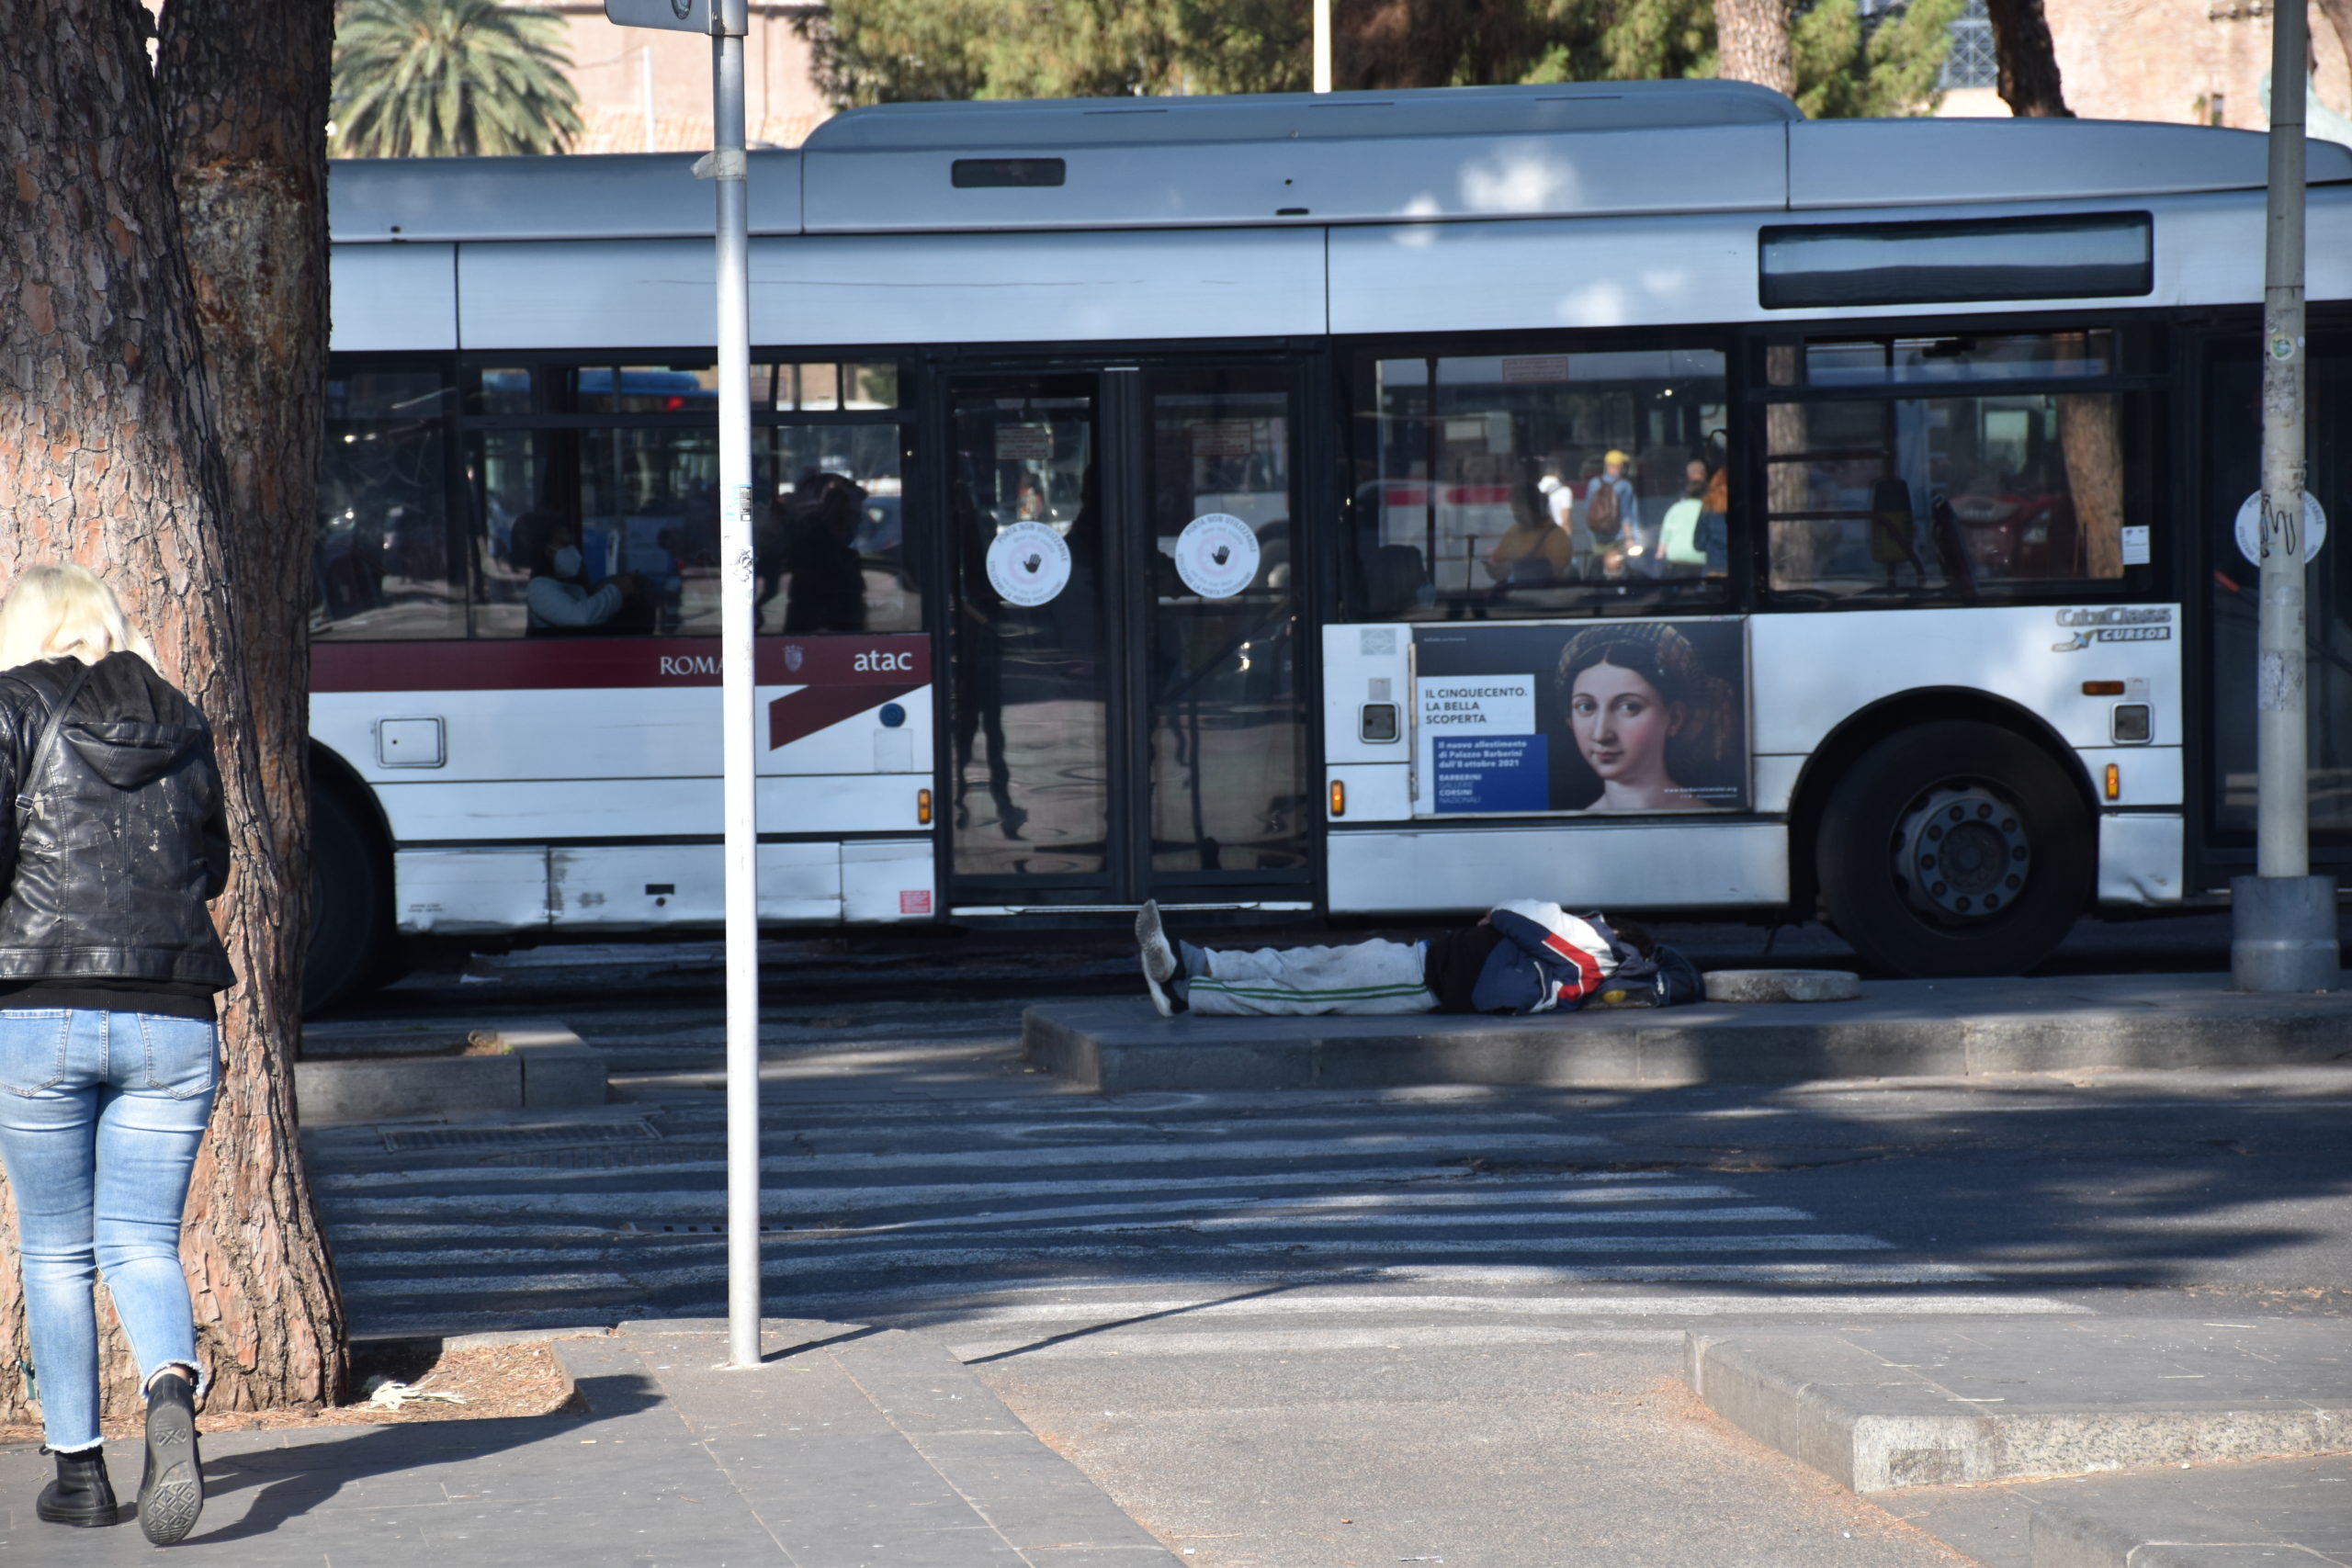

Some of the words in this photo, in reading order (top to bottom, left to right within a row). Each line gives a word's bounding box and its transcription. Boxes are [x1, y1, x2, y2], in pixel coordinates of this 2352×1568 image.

[2056, 607, 2172, 626] CityClass
[2101, 628, 2169, 640] CURSOR
[854, 649, 913, 671] atac
[1425, 688, 1435, 698] IL
[1438, 687, 1528, 698] CINQUECENTO.
[1426, 702, 1441, 711] LA
[1443, 701, 1480, 711] BELLA
[1426, 714, 1487, 724] SCOPERTA
[1475, 740, 1527, 749] allestimento
[1449, 750, 1481, 759] Palazzo
[1483, 750, 1522, 758] Barberini
[1464, 760, 1496, 768] ottobre
